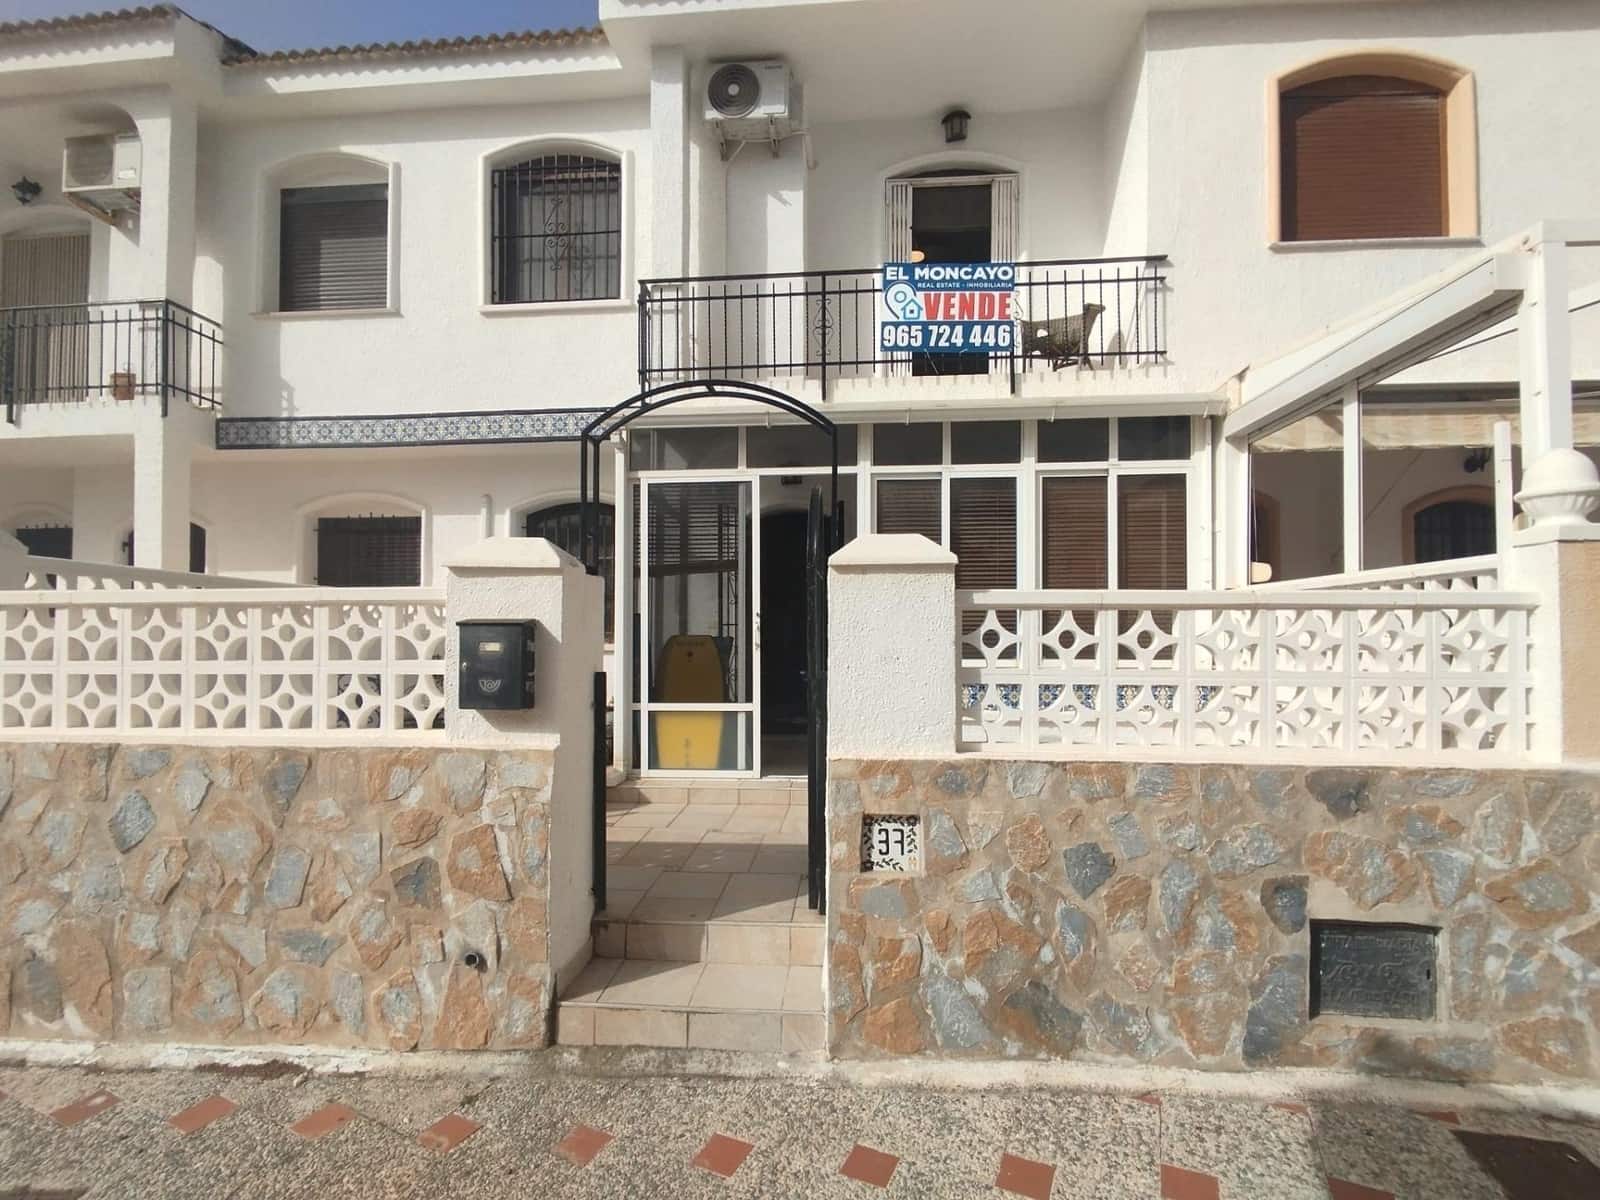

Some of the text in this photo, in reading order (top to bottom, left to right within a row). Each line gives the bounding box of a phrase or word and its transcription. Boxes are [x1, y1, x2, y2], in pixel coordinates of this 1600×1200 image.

[886, 266, 1013, 280] EL MONCAYO
[924, 293, 1011, 320] VENDE
[883, 325, 1010, 347] 965 724 446
[878, 828, 904, 856] 37
